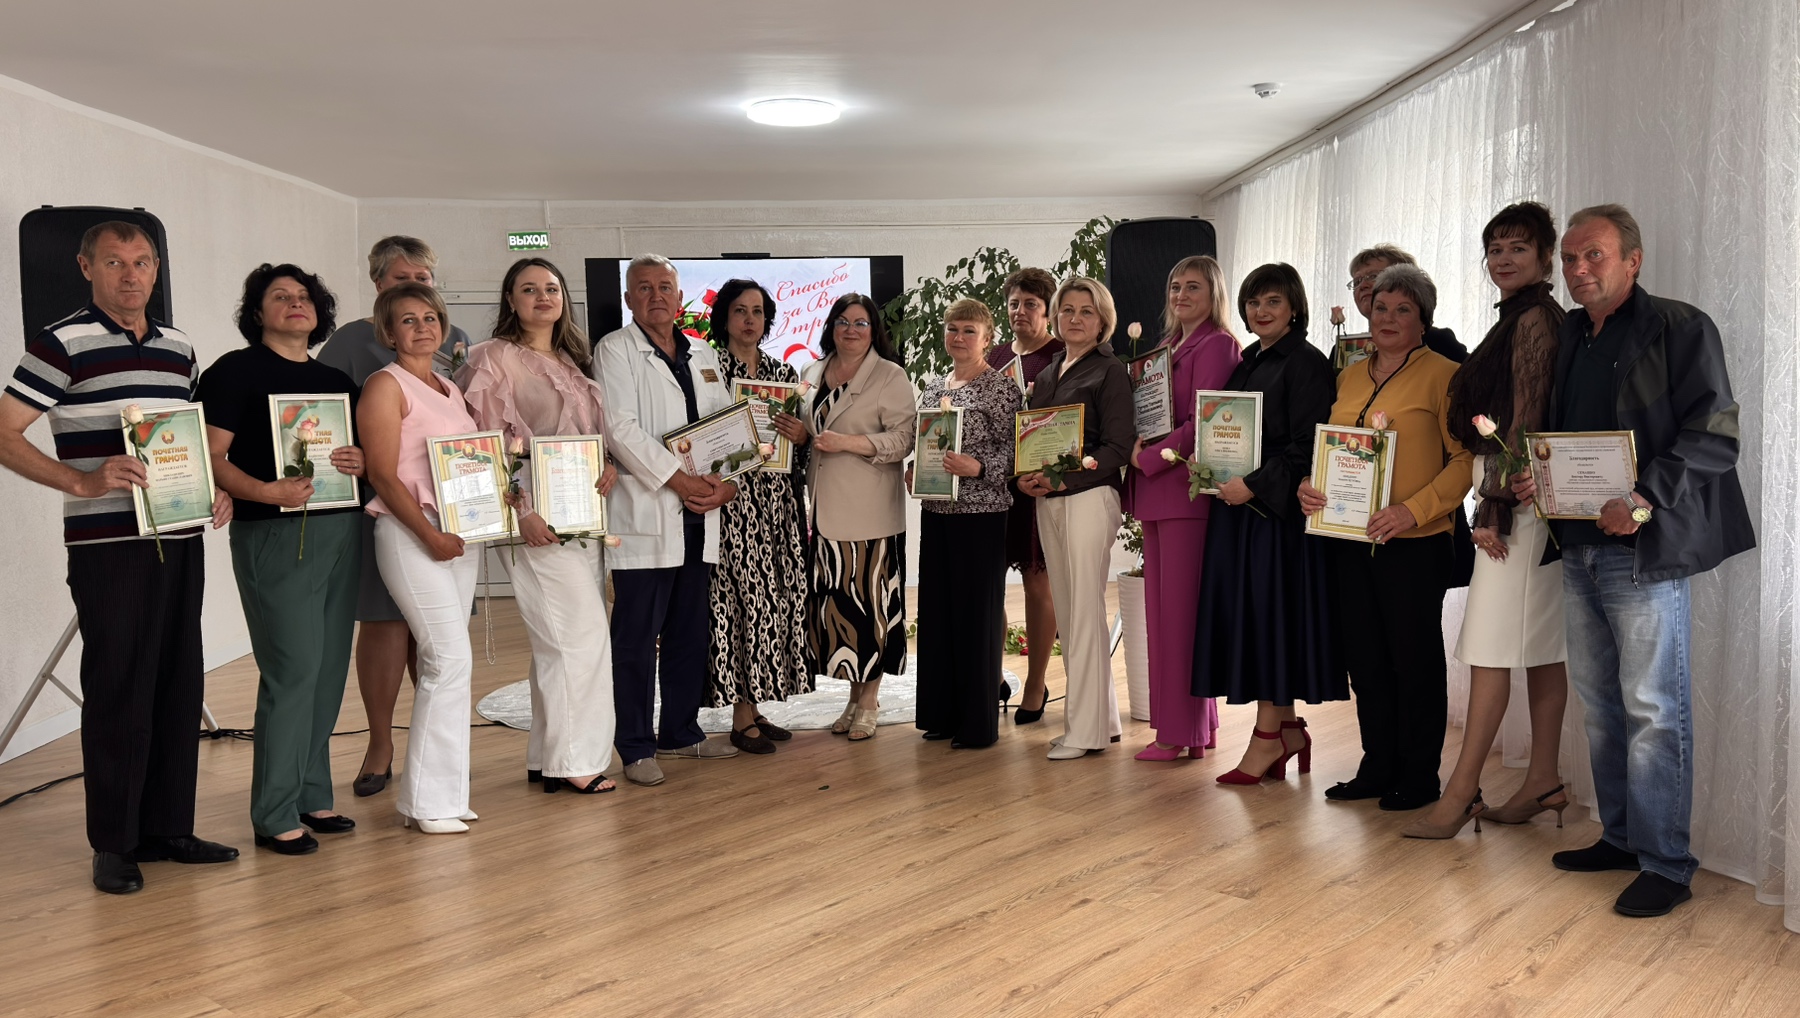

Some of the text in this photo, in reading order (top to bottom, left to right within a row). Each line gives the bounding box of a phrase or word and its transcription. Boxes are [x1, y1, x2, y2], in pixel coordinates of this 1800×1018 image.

[509, 234, 549, 246] ВЫХОД
[776, 262, 849, 301] Спасибо
[775, 285, 841, 338] за Ва
[791, 317, 823, 345] тр
[1213, 431, 1241, 439] ГРАМОТА
[152, 445, 189, 456] ПОЧЕТНАЯ
[154, 453, 189, 465] ГРАМОТА
[1334, 455, 1369, 465] ПОЧЕТНАЯ
[455, 461, 488, 470] ПОЧЕТНАЯ
[459, 467, 488, 475] ГРАМОТА
[1337, 461, 1367, 470] ГРАМОТА
